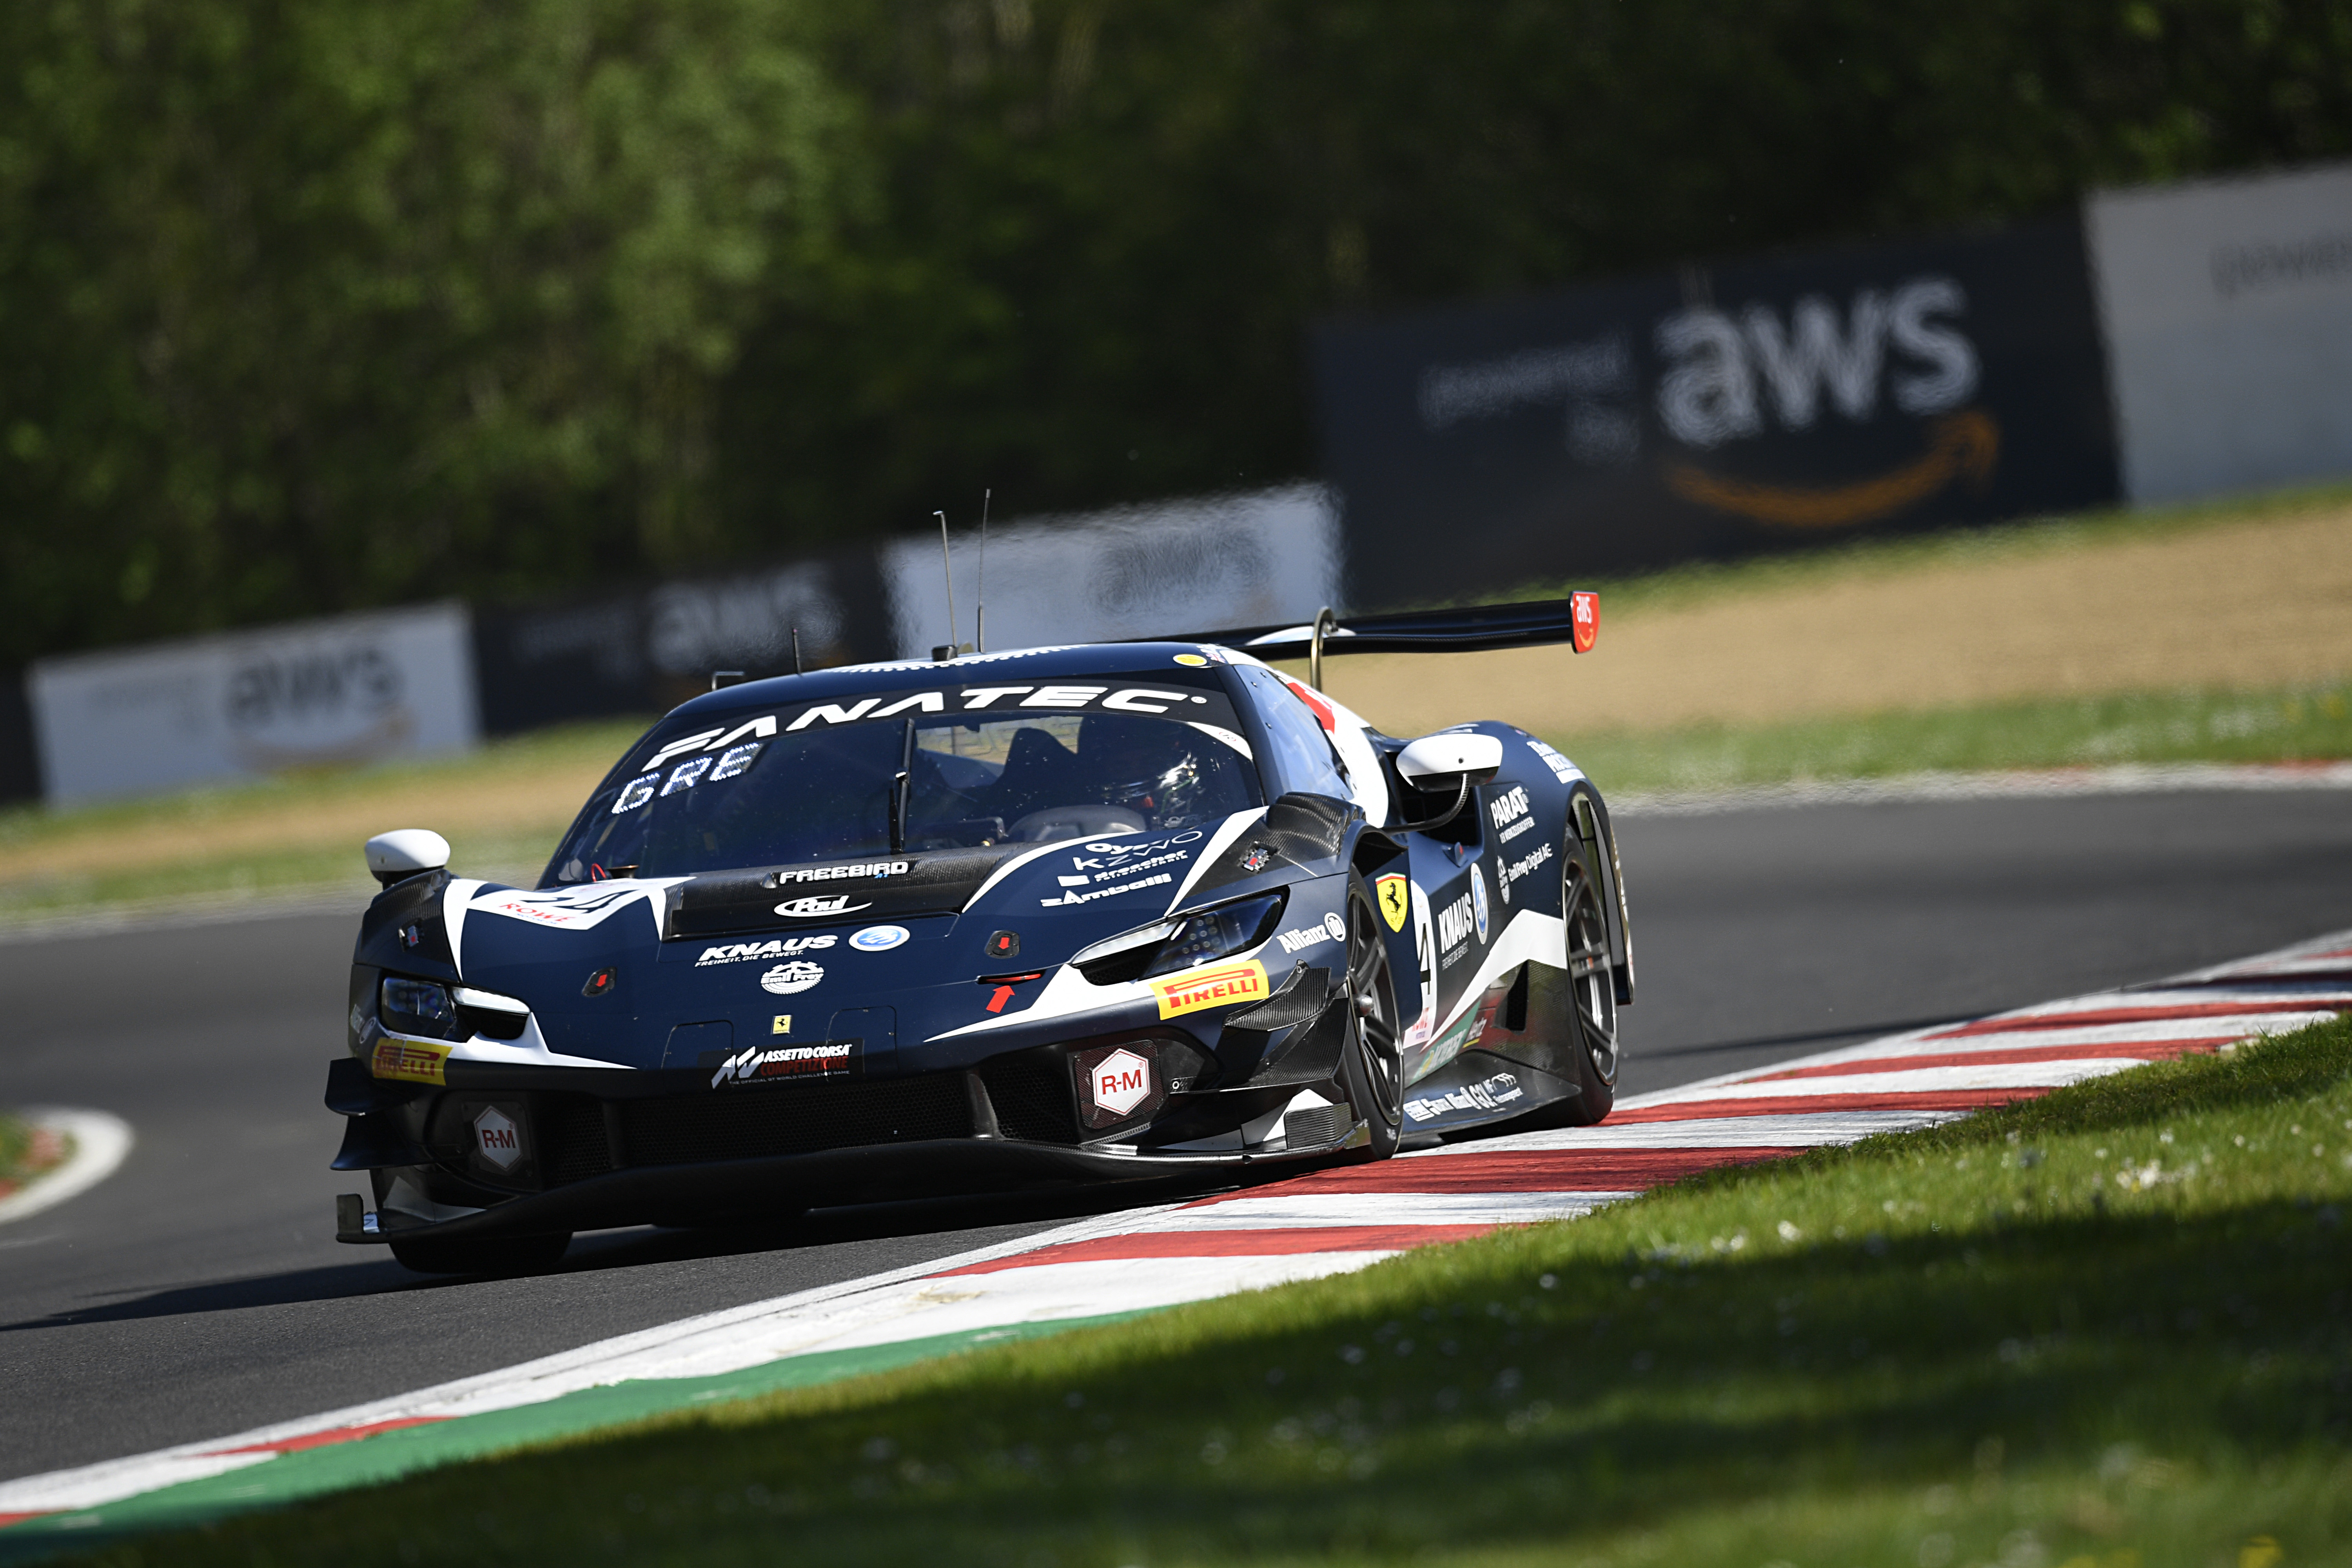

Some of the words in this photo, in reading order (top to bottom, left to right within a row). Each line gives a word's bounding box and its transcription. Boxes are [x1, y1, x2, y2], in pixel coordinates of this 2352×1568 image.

[1653, 274, 1980, 447] aws
[1576, 595, 1593, 624] aws
[224, 645, 405, 730] aws
[641, 686, 1188, 772] FANATEC
[612, 742, 763, 814] GRE
[1490, 786, 1528, 829] PARAT
[1515, 860, 1529, 875] Frey
[1525, 848, 1544, 870] Digital
[1541, 842, 1553, 860] AG
[779, 862, 909, 884] FREEBIRD
[499, 903, 576, 922] ROWE
[791, 895, 849, 914] Paul
[1438, 892, 1473, 954] KNAUS
[699, 935, 838, 961] KNAUS
[1276, 924, 1331, 954] Allianz
[694, 956, 741, 967] FREIHEIT.
[761, 950, 804, 959] BEWEGT.
[761, 973, 791, 984] Emil
[1163, 968, 1259, 1009] PIRELLI
[760, 1056, 849, 1076] COMPETIZIONE
[764, 1047, 810, 1063] ASSETTO
[812, 1044, 850, 1058] CORSA
[1101, 1069, 1142, 1095] R-M
[482, 1129, 516, 1149] R-M
